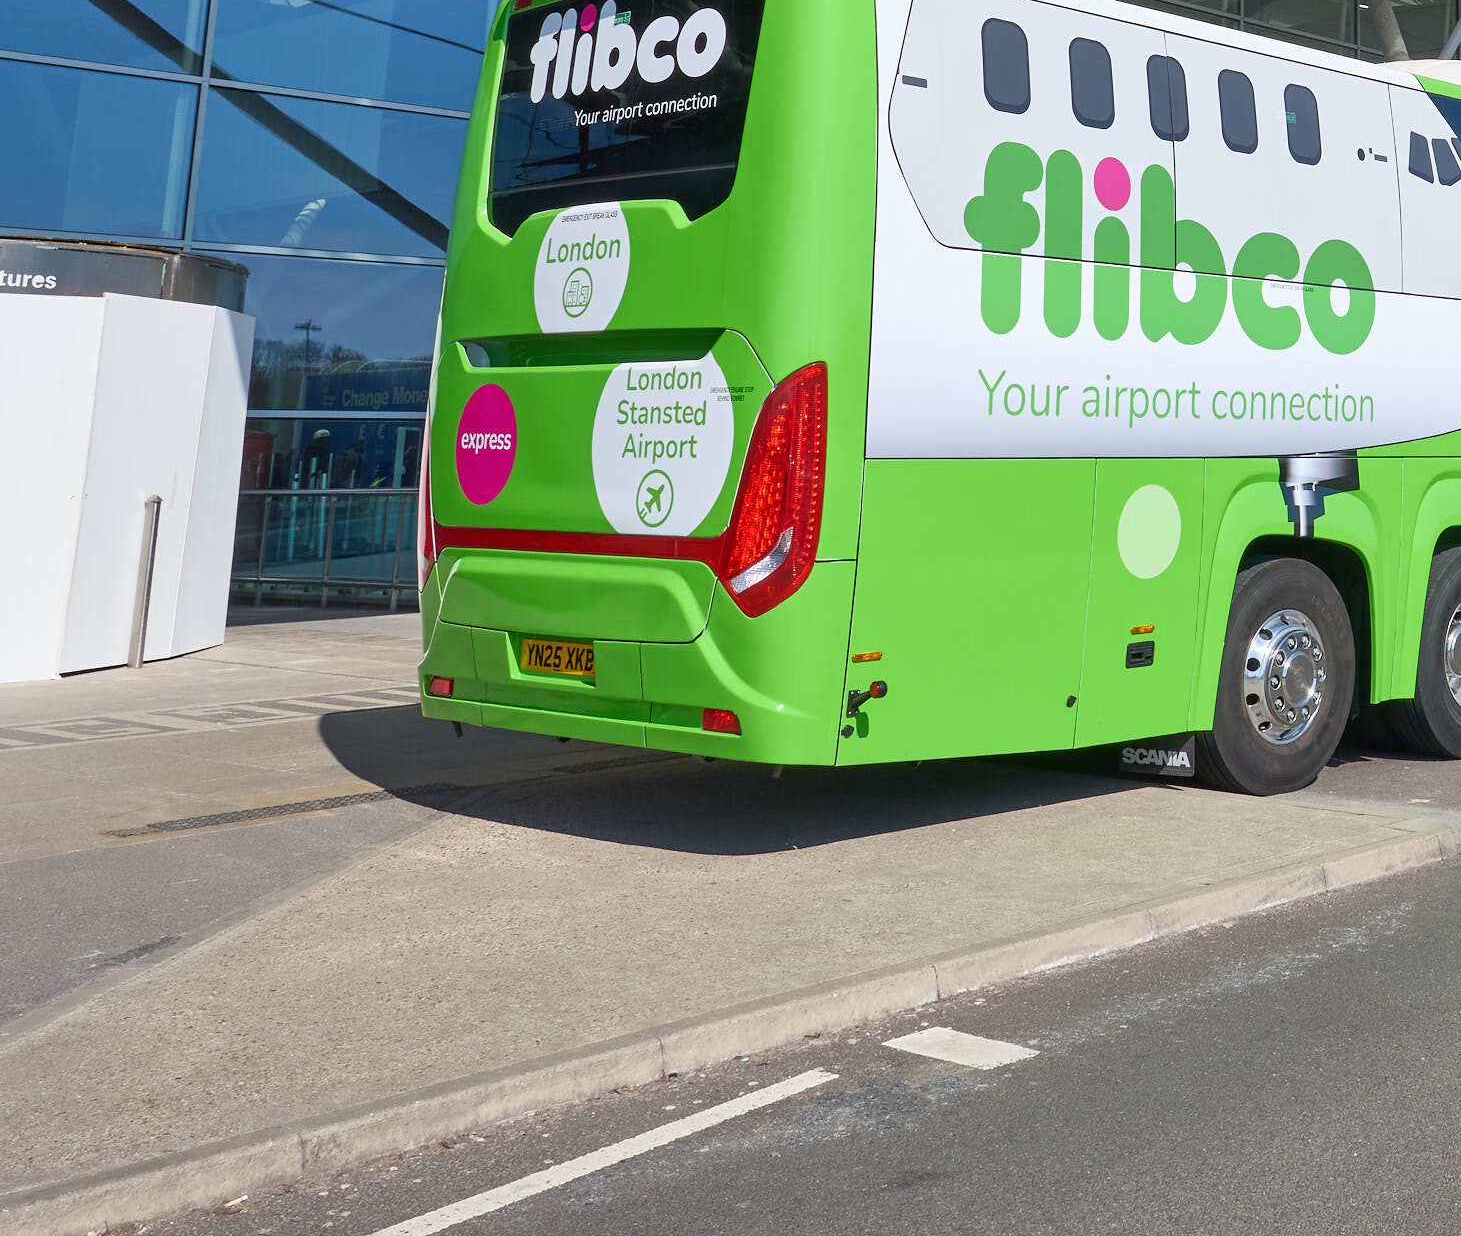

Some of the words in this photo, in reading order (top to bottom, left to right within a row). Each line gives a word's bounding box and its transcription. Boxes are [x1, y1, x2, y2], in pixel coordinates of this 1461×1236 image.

[530, 0, 727, 104] flibco
[574, 109, 601, 127] Your
[602, 102, 643, 124] airport
[645, 92, 718, 116] connection
[545, 233, 621, 264] London
[963, 141, 1376, 355] flibco
[626, 365, 702, 391] London
[342, 388, 390, 410] Change
[392, 386, 429, 405] Mone
[978, 368, 1069, 417] Your
[1082, 374, 1200, 428] airport
[1212, 384, 1374, 422] connection
[616, 400, 707, 426] Stansted
[460, 430, 512, 453] express
[621, 432, 698, 465] Airport
[527, 643, 563, 669] YN25
[1121, 747, 1192, 768] SCANIA
